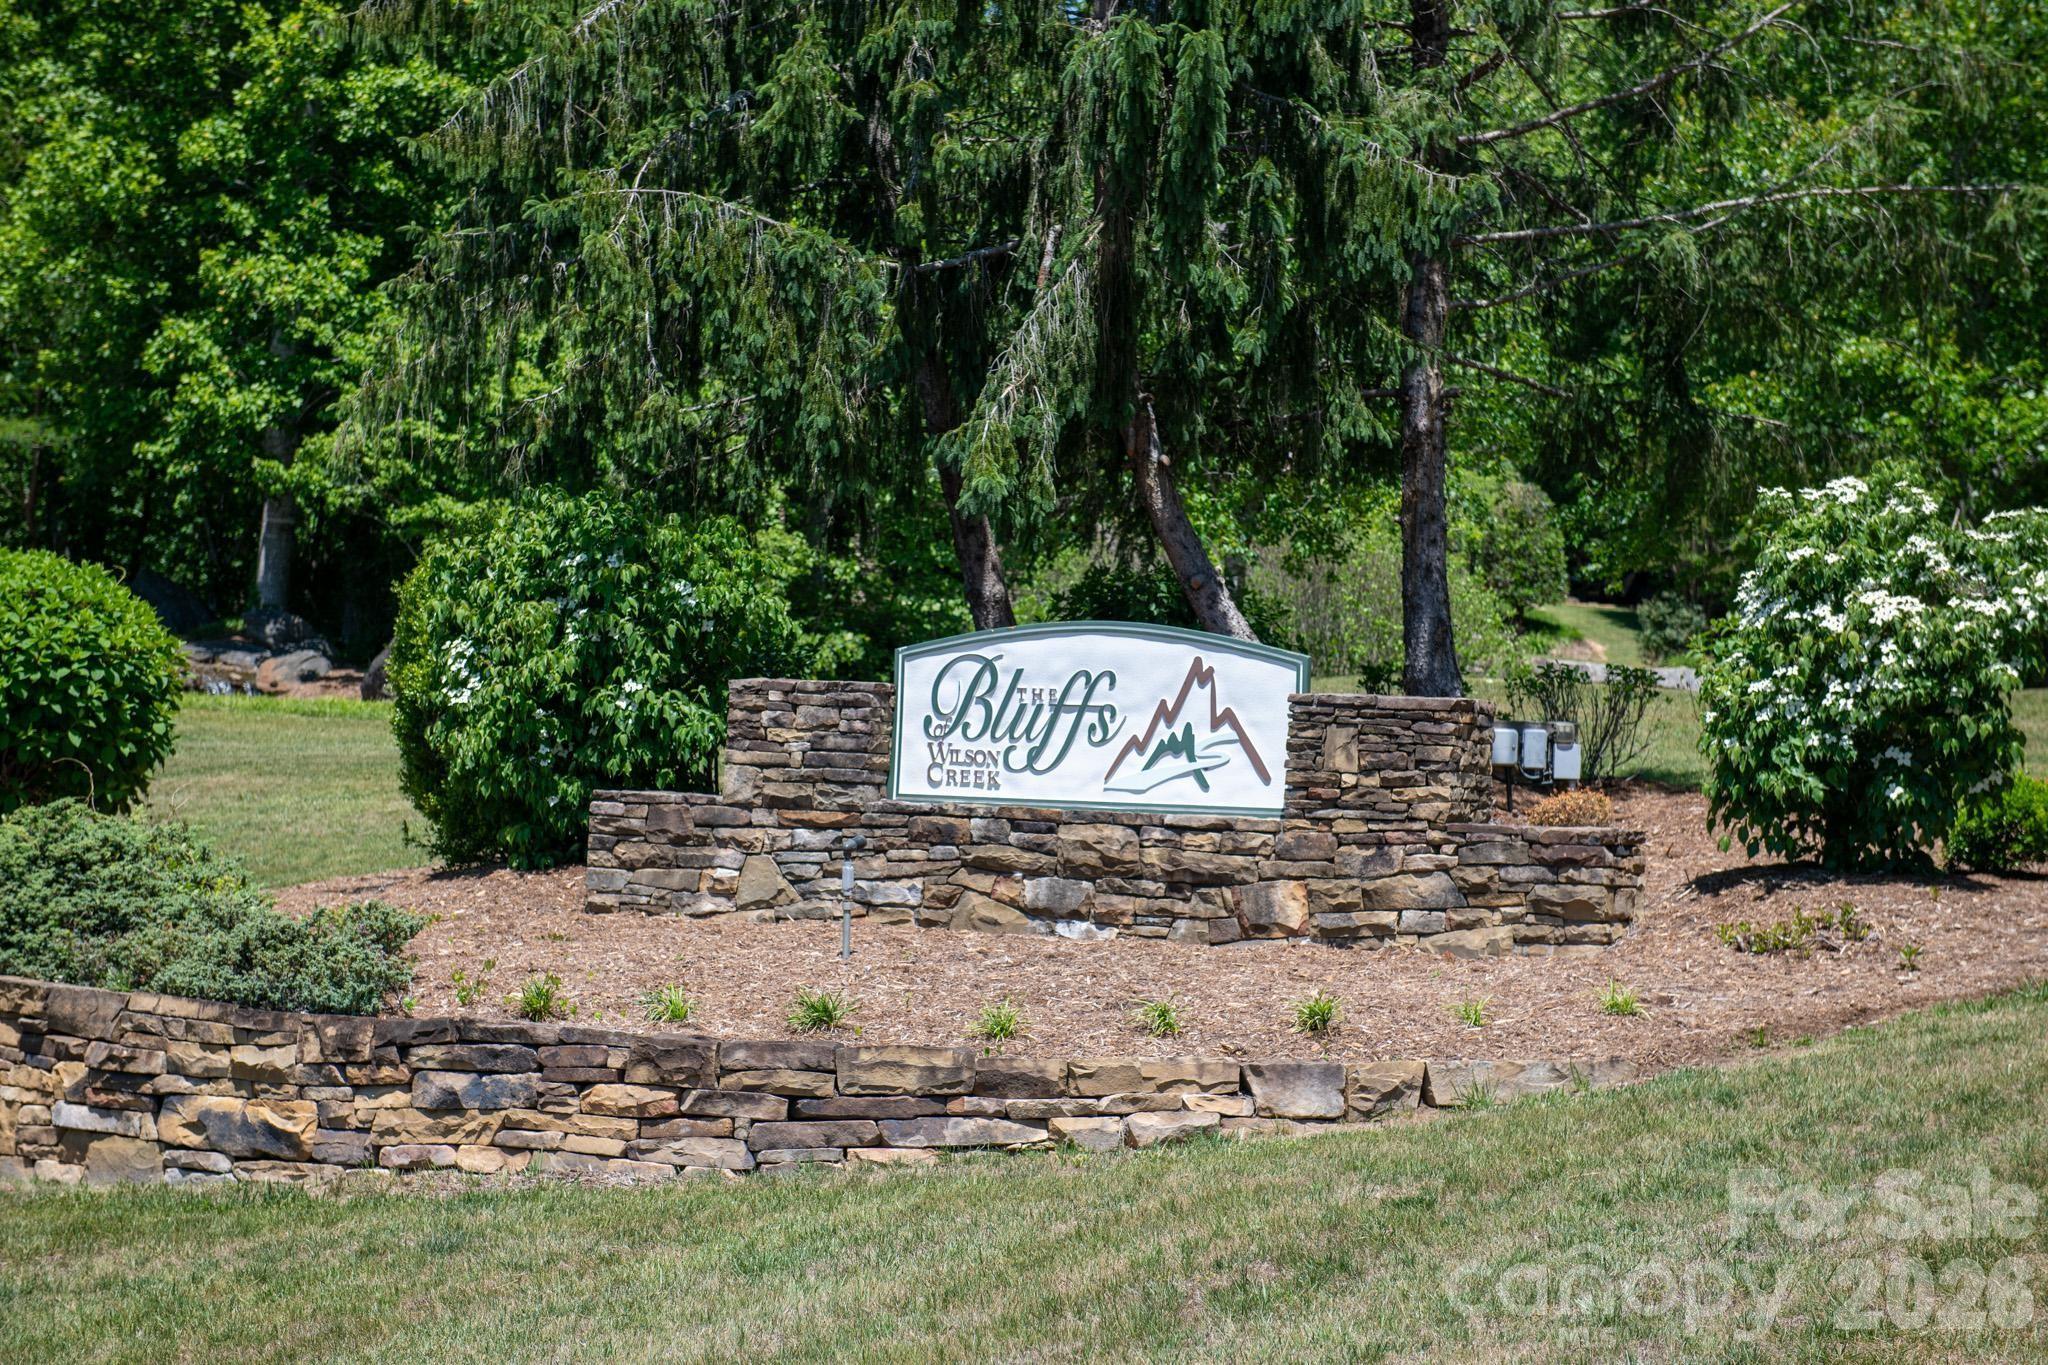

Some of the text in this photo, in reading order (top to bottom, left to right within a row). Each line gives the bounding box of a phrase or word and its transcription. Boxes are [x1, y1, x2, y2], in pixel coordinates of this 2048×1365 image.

[1016, 687, 1058, 703] THE
[924, 653, 1127, 775] Bluffs
[928, 742, 1000, 768] WILSON
[927, 763, 1001, 790] CREEK
